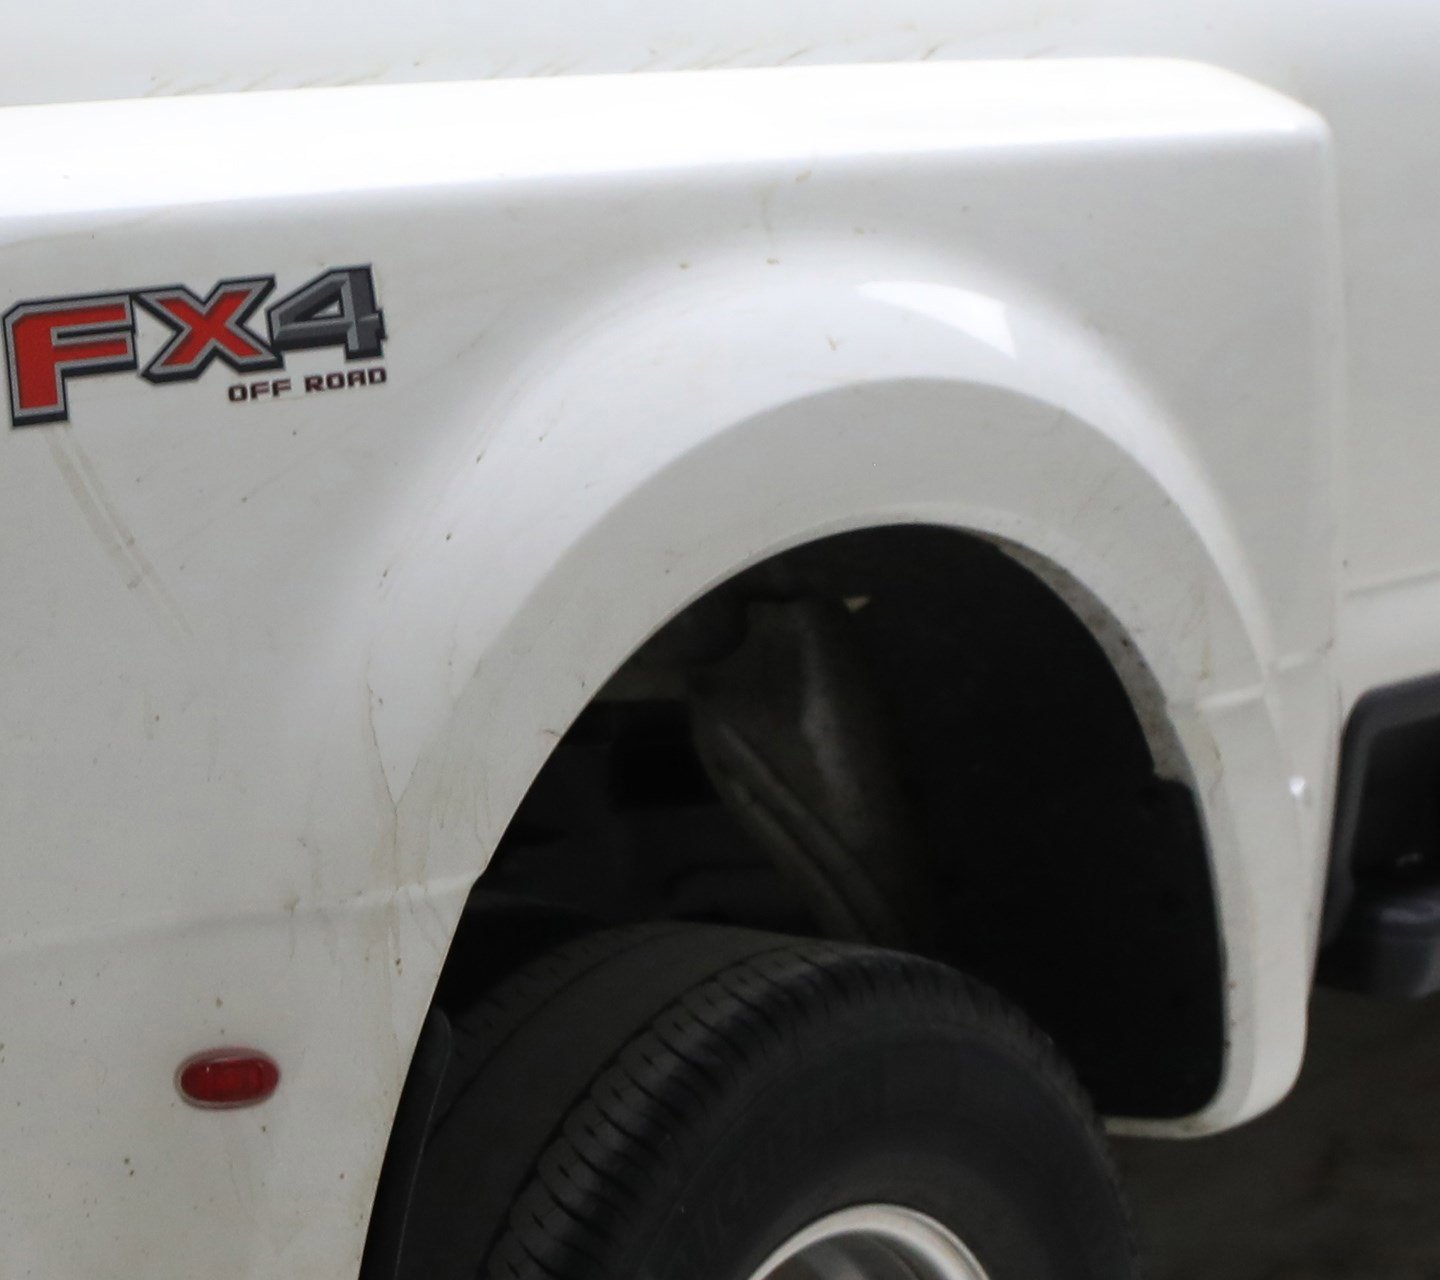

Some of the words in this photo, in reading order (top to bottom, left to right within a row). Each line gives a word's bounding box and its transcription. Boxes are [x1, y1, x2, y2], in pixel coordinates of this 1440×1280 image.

[0, 263, 388, 429] FX4
[227, 377, 292, 404] OFF
[304, 366, 388, 394] ROAD
